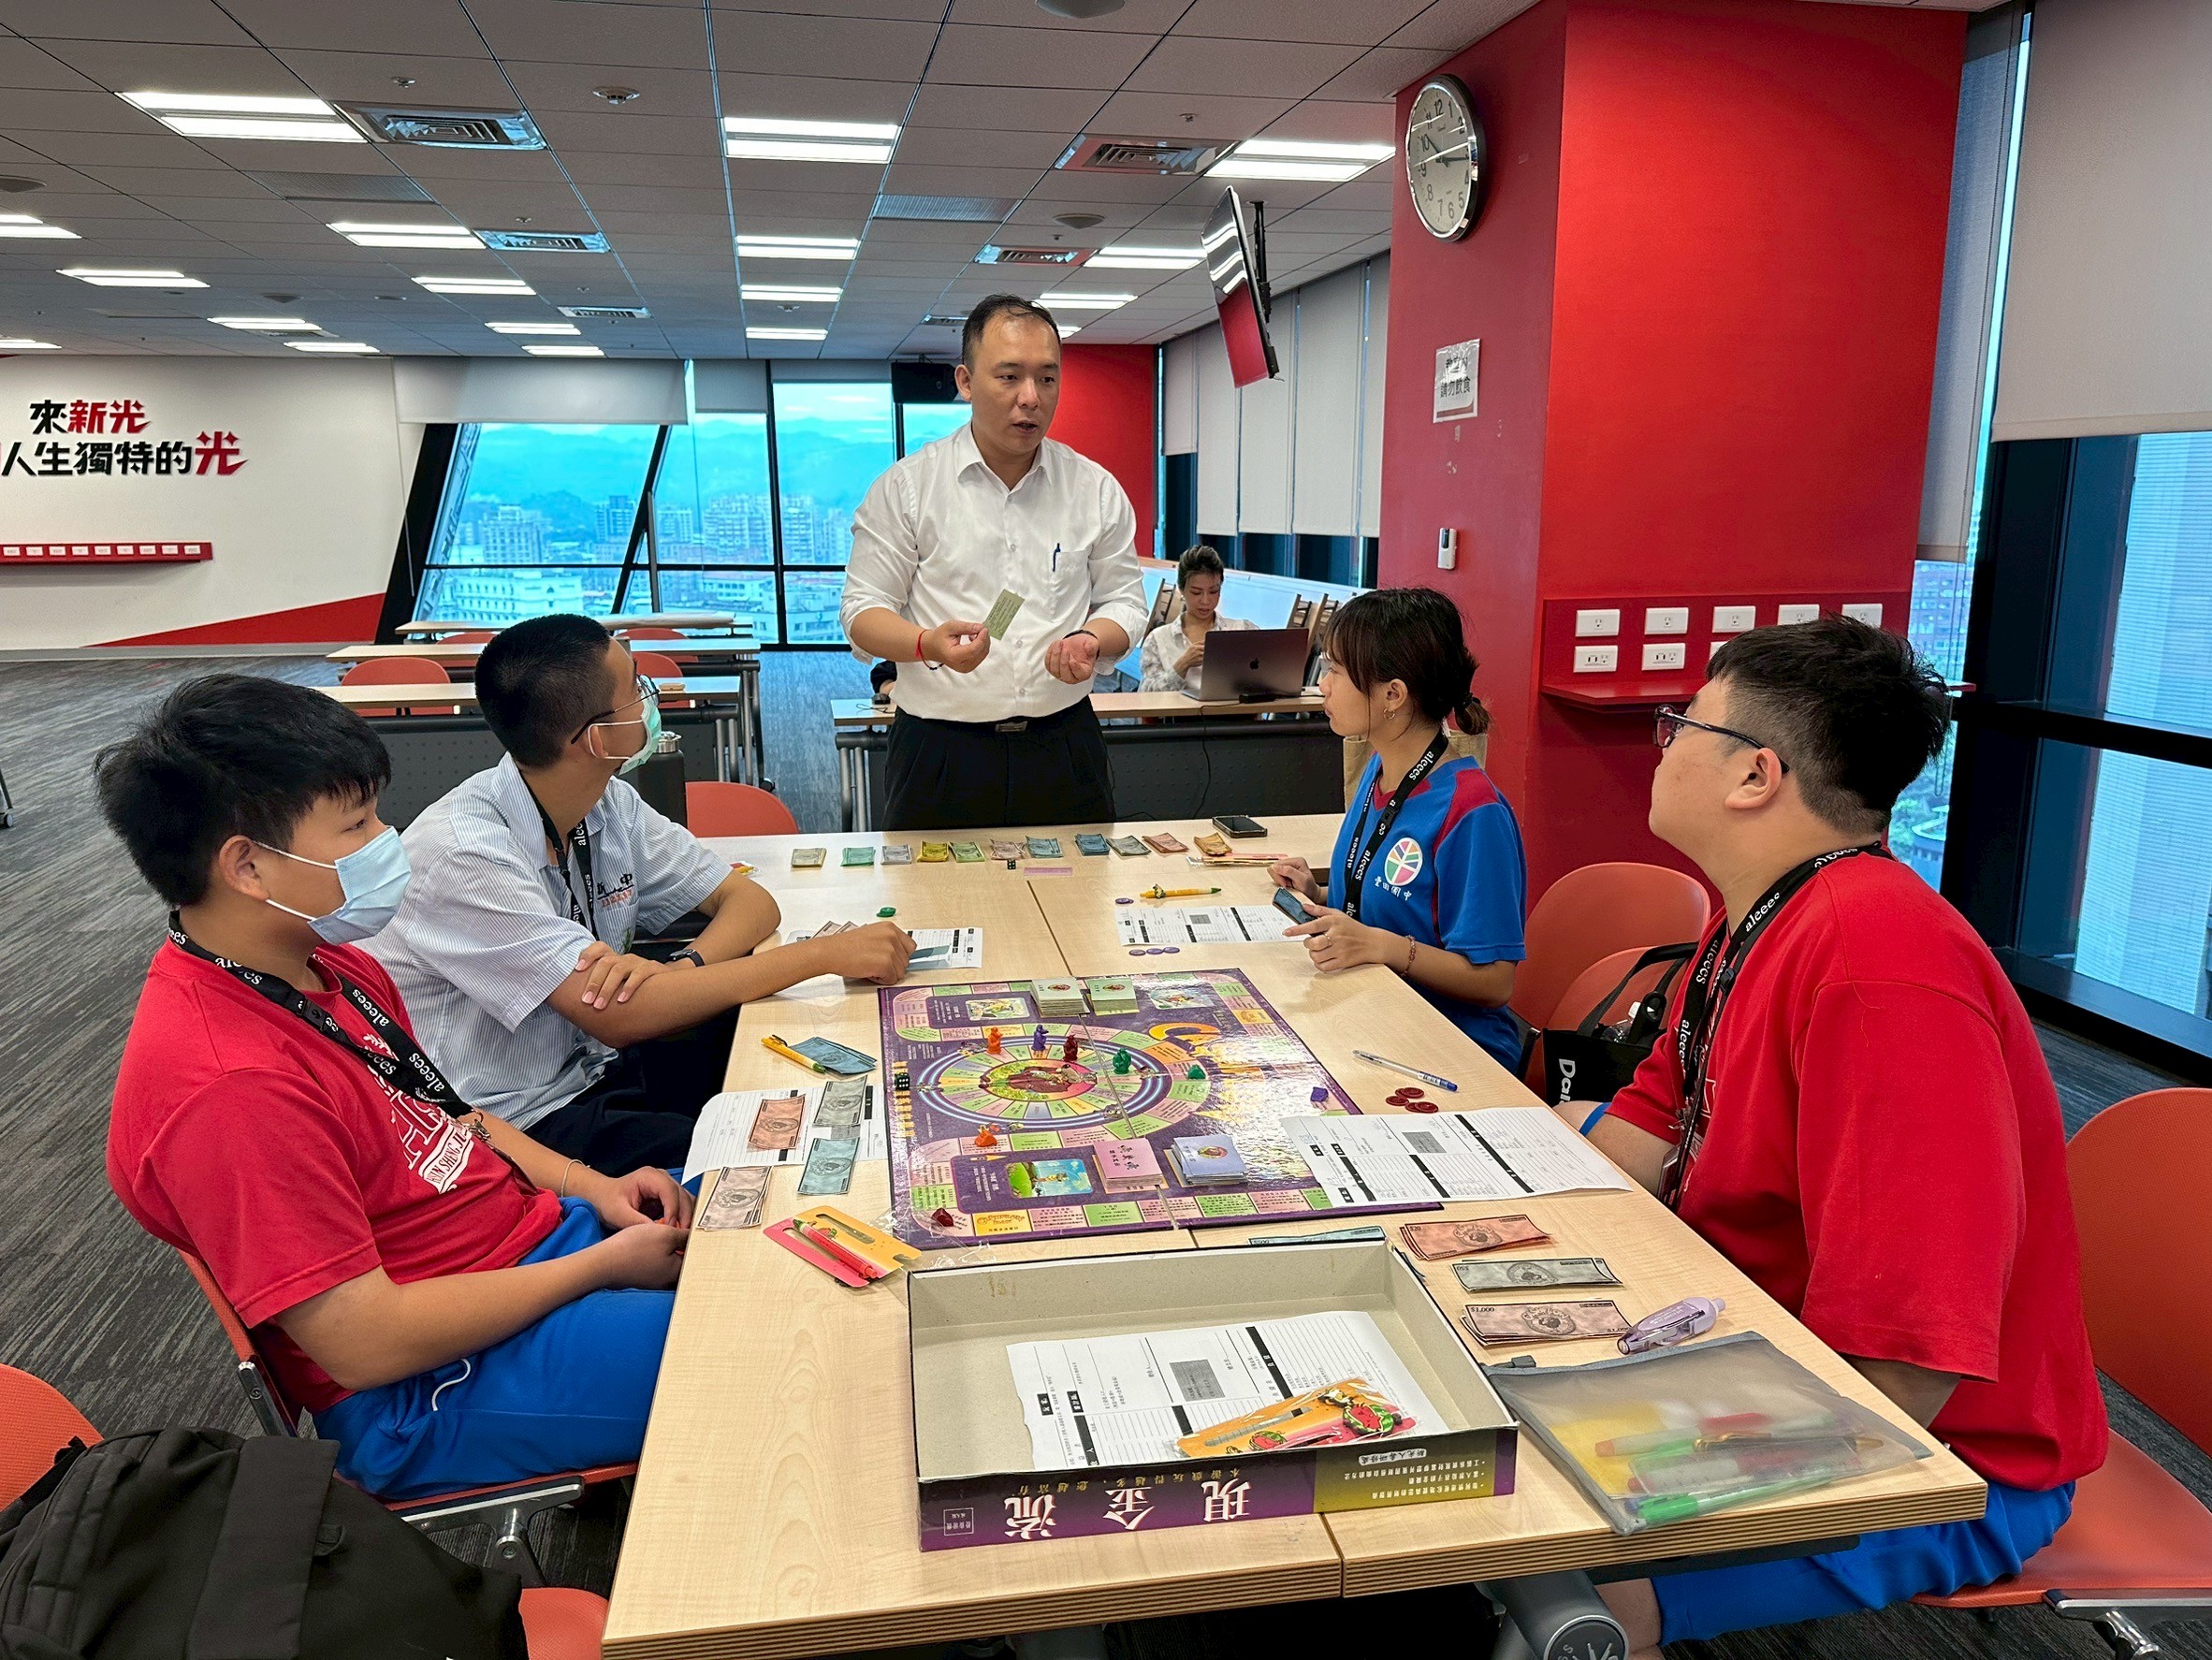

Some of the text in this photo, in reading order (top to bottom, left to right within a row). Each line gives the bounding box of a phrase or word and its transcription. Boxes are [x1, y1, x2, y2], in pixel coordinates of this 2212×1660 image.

[1433, 98, 1443, 117] 12
[1458, 116, 1465, 135] 2
[1420, 162, 1427, 178] 9
[1463, 169, 1470, 185] 4
[1427, 183, 1433, 202] 8
[1458, 191, 1465, 210] 5
[1437, 198, 1444, 217] 7
[1448, 201, 1455, 220] 6
[1440, 375, 1471, 398] 請勿飲食
[29, 399, 152, 435] 來新光
[1, 430, 249, 476] 人生獨特的光
[438, 1142, 461, 1172] SHENG
[1003, 1478, 1251, 1541] 現金流
